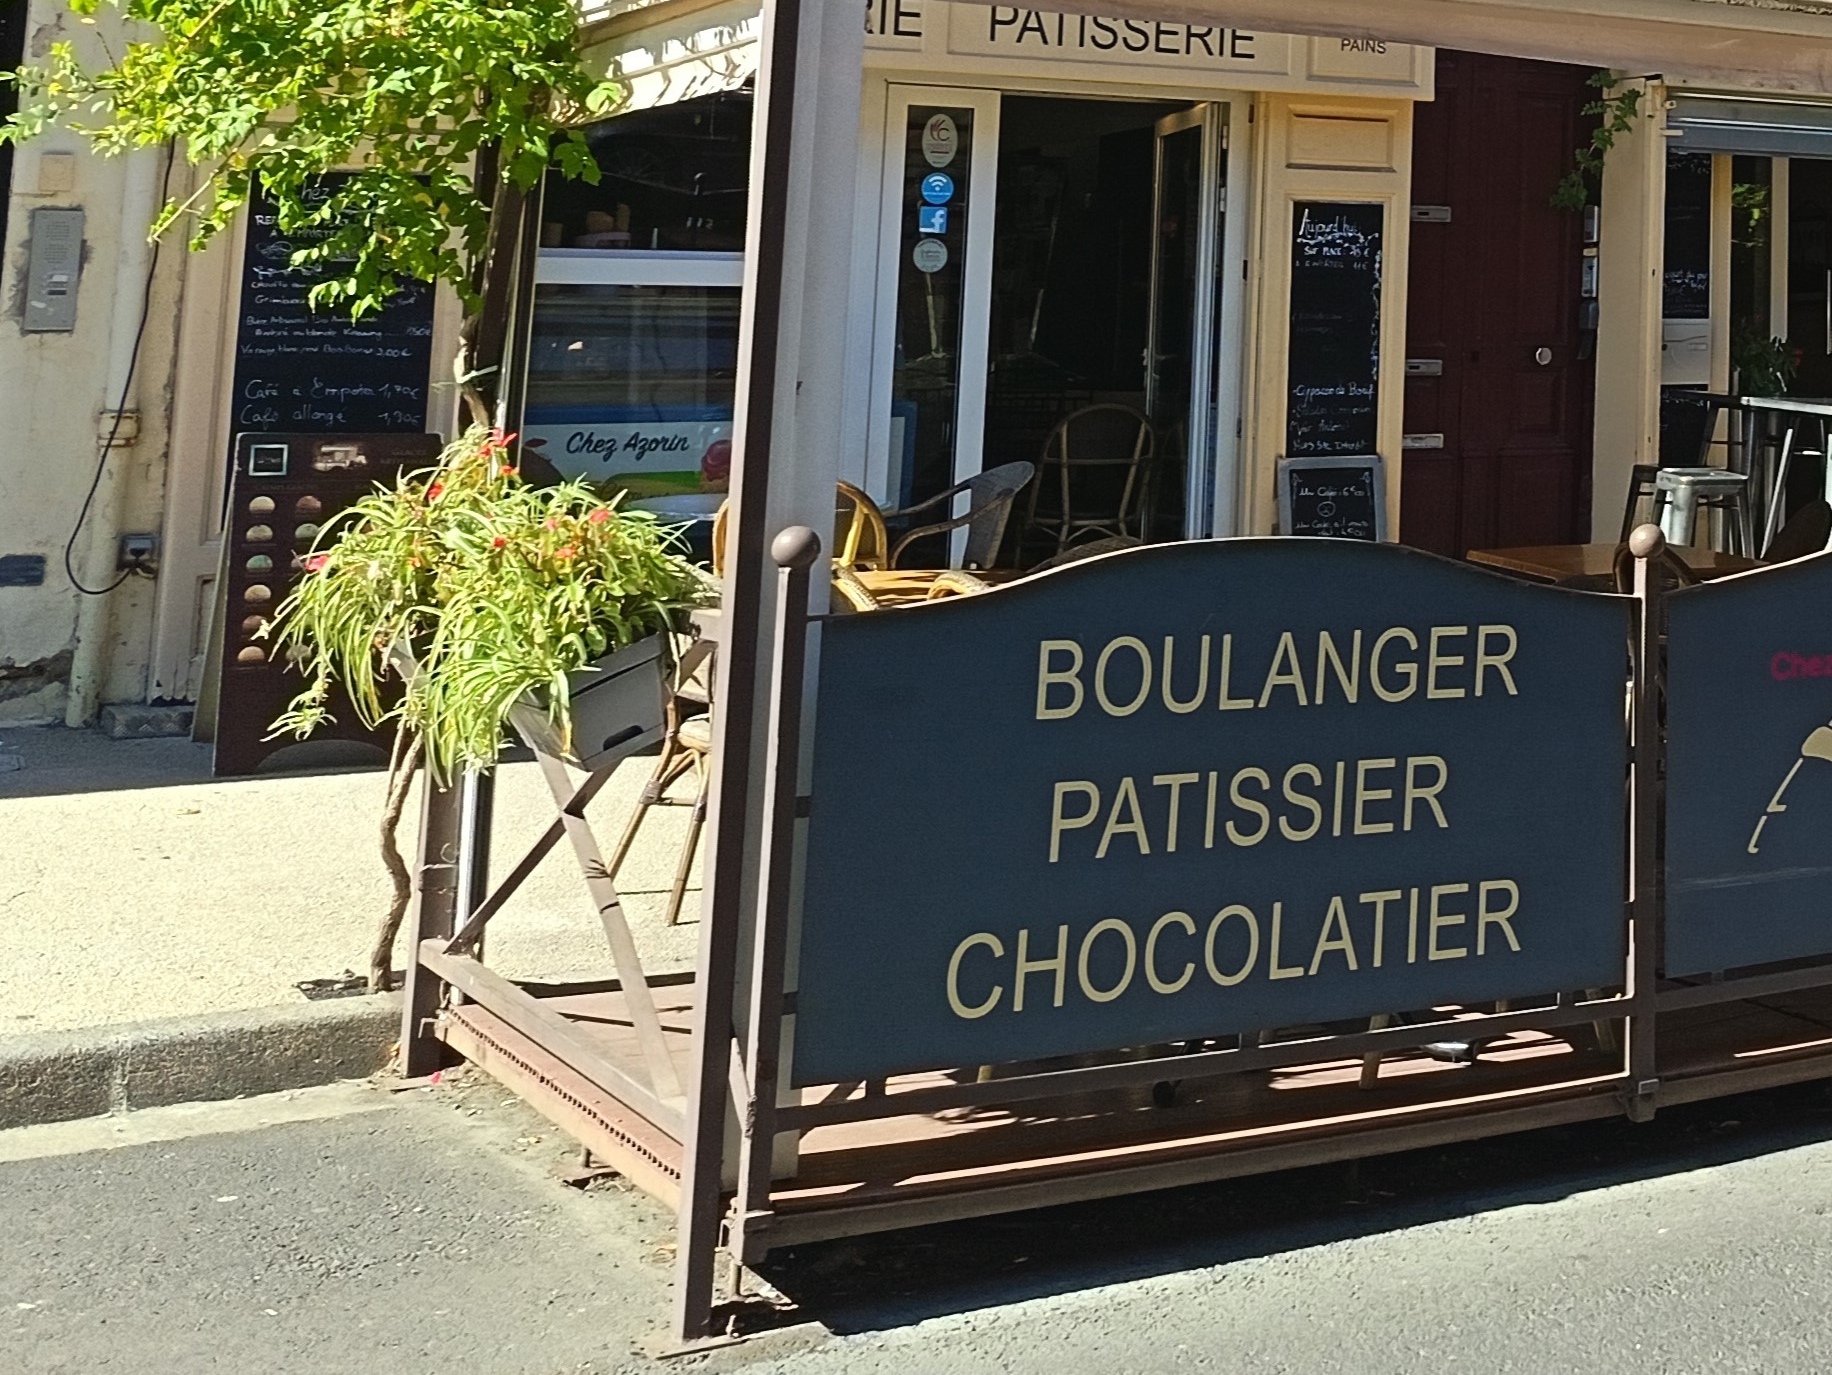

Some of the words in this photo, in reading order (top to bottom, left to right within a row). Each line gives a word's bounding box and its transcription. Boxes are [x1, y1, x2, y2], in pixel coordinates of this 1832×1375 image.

[989, 5, 1256, 59] PATISSERIE
[1341, 38, 1386, 54] PAINS
[566, 431, 618, 463] Chez
[623, 431, 690, 461] Azorin
[1035, 624, 1518, 720] BOULANGER
[1048, 755, 1449, 863] PATISSIER
[946, 879, 1521, 1019] CHOCOLATIER
